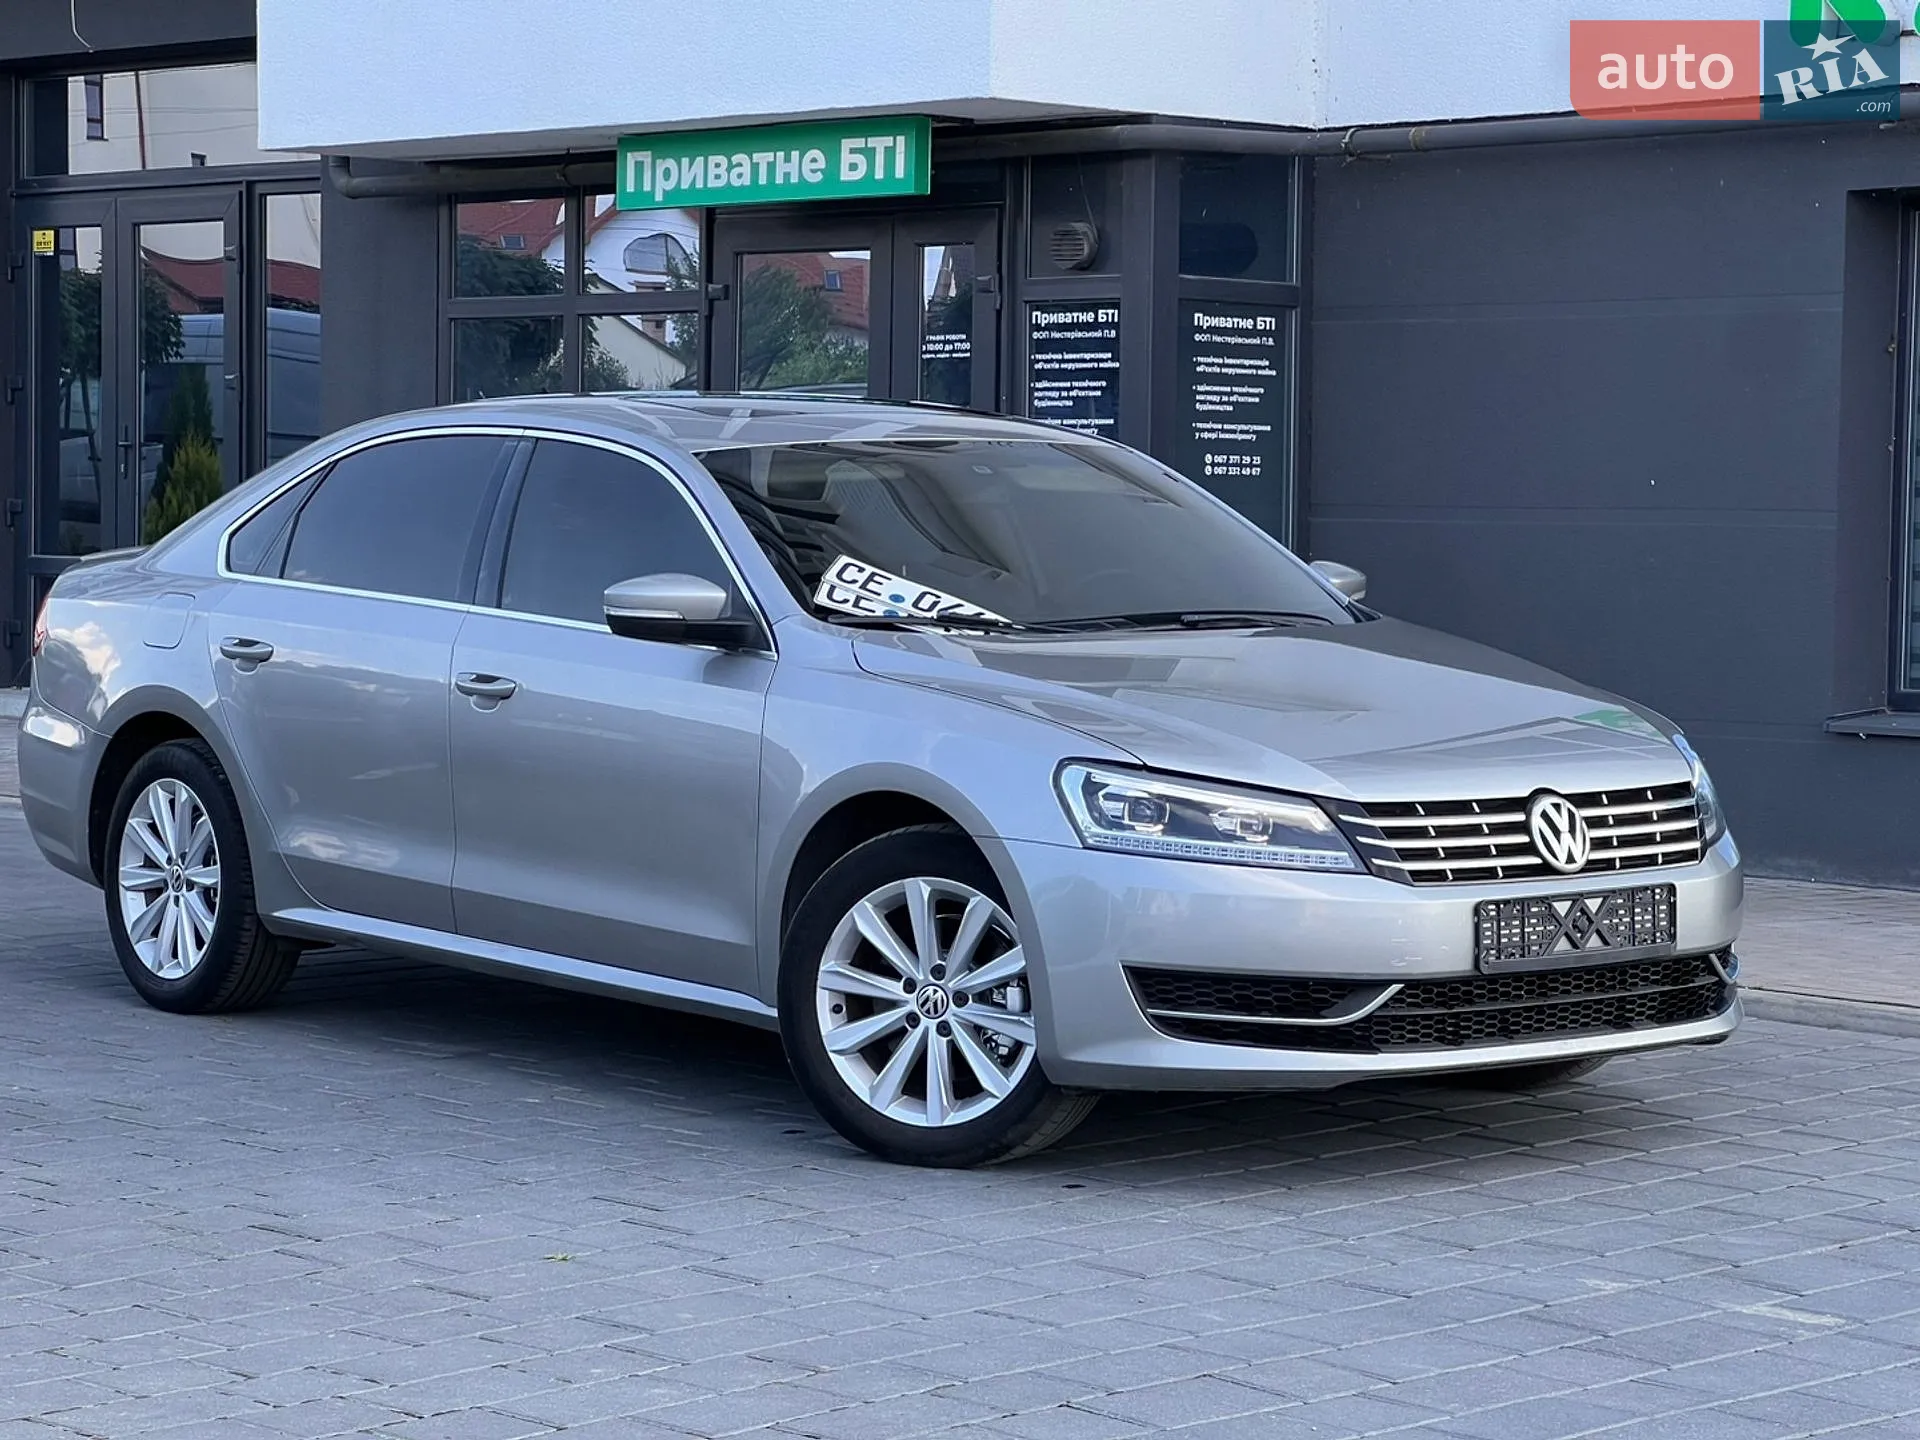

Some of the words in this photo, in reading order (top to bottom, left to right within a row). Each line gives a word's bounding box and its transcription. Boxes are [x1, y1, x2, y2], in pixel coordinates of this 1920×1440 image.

[626, 149, 827, 202] Приватне
[840, 135, 906, 181] БТІ
[1031, 310, 1095, 328] Приватне
[1098, 309, 1119, 323] БТІ
[1194, 312, 1254, 330] Приватне
[1256, 316, 1276, 331] БТІ
